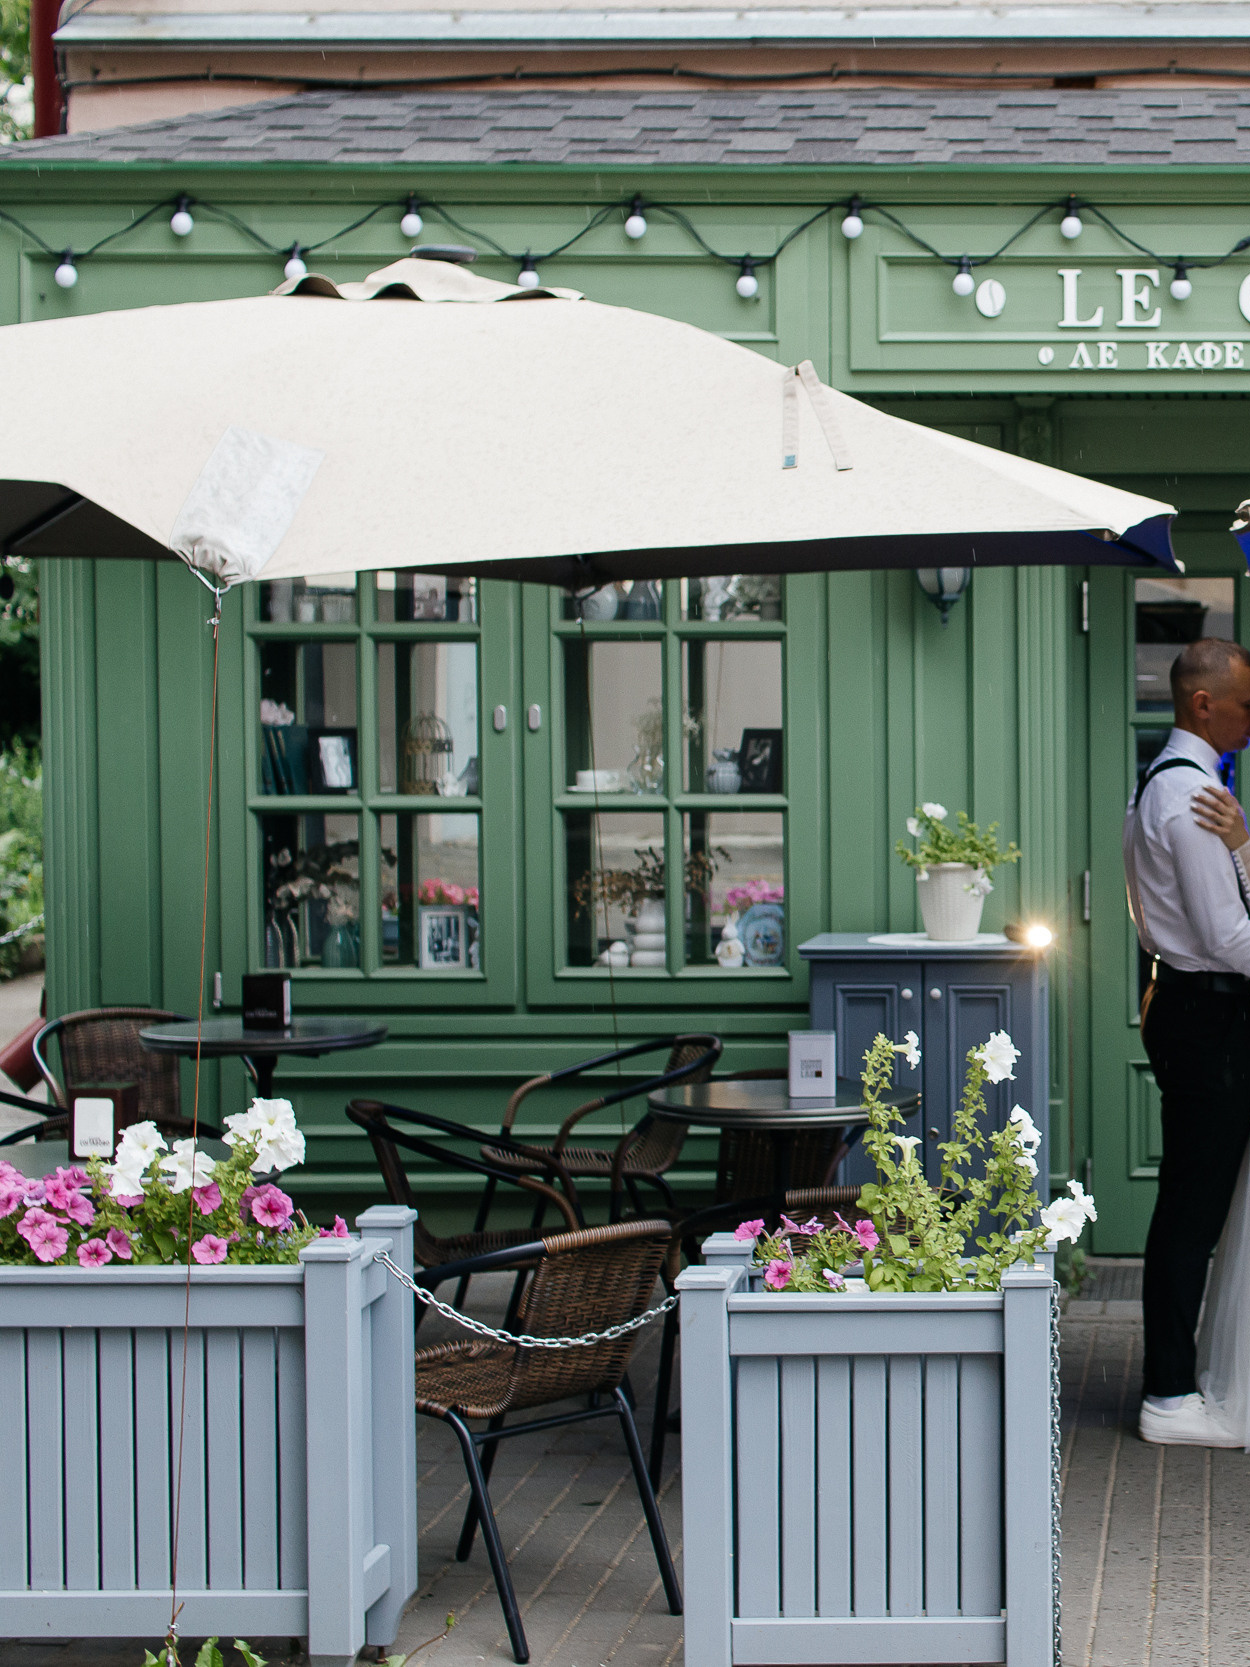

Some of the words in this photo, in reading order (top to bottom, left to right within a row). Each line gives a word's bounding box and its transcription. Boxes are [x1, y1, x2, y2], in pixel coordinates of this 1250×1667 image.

[1057, 268, 1162, 328] LE
[1069, 341, 1118, 370] ЛЕ
[1146, 341, 1245, 370] КАФЕ
